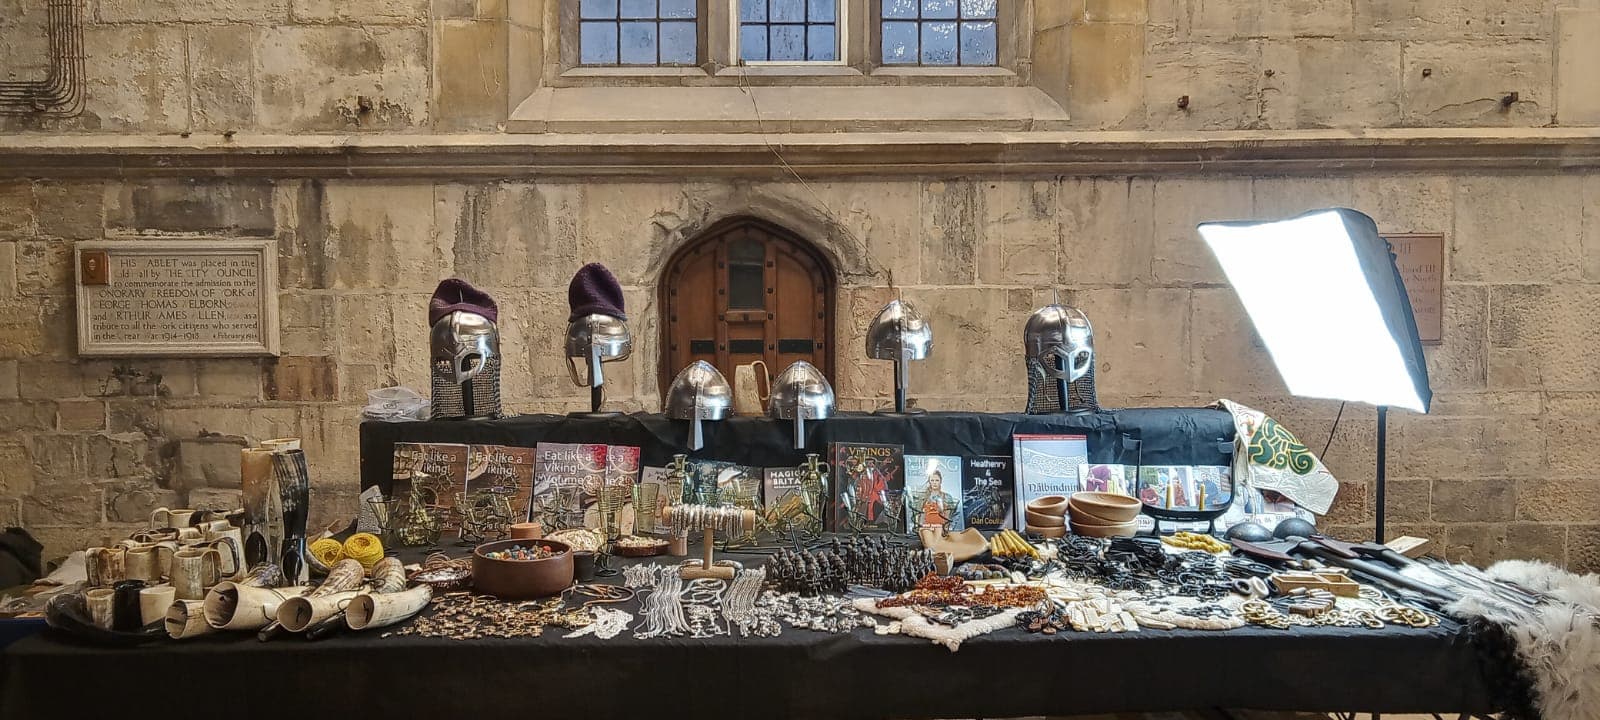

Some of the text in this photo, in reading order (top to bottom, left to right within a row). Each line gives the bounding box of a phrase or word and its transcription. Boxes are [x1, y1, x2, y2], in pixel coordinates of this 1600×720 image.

[119, 258, 256, 270] HIS ABLET was placed in the
[151, 267, 161, 281] by
[216, 268, 256, 278] OUNCIL
[113, 281, 123, 289] to
[124, 280, 178, 288] commemorate
[180, 278, 194, 288] the
[196, 278, 232, 287] admission
[243, 278, 257, 288] the
[99, 288, 146, 299] ONORARY
[201, 288, 216, 298] OF
[223, 288, 246, 298] ORK
[247, 288, 257, 298] of
[99, 299, 131, 310] EORGE
[140, 299, 178, 309] HOMAS
[93, 311, 107, 321] and
[116, 310, 152, 320] RTHUR
[158, 310, 188, 320] AMES
[198, 310, 227, 321] LLEN,
[92, 320, 258, 332] tribute to all the ork citizens who served
[93, 332, 101, 341] in
[102, 331, 116, 340] the
[430, 449, 449, 462] like
[450, 454, 457, 462] a
[475, 451, 523, 464] Eat like a
[544, 450, 592, 461] Eat like a
[848, 447, 891, 457] VIINGS
[544, 462, 580, 475] Viking!
[970, 459, 1007, 470] Heathenry
[542, 474, 584, 486] Volume
[974, 477, 1003, 486] The Sea
[971, 517, 984, 525] Dan
